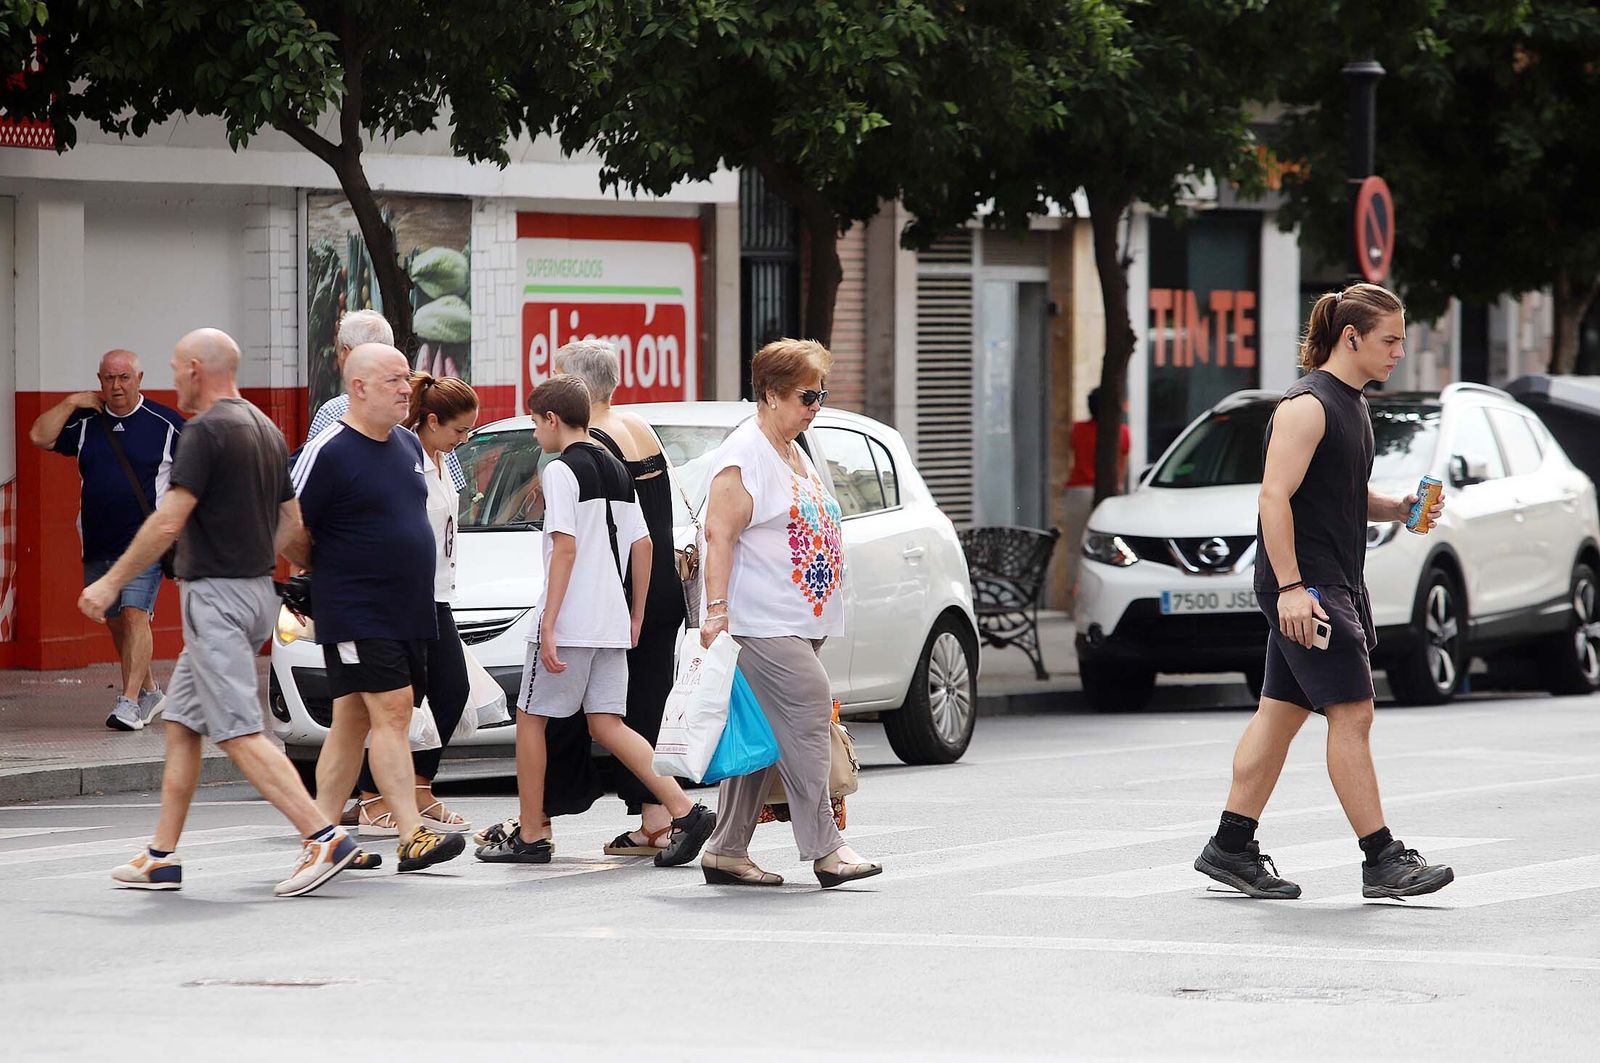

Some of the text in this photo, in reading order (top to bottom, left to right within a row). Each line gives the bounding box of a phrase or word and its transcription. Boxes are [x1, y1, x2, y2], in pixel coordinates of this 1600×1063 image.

[526, 257, 603, 279] SUPERMERCADOS
[1149, 288, 1256, 368] TINTE
[1173, 592, 1219, 610] 7500
